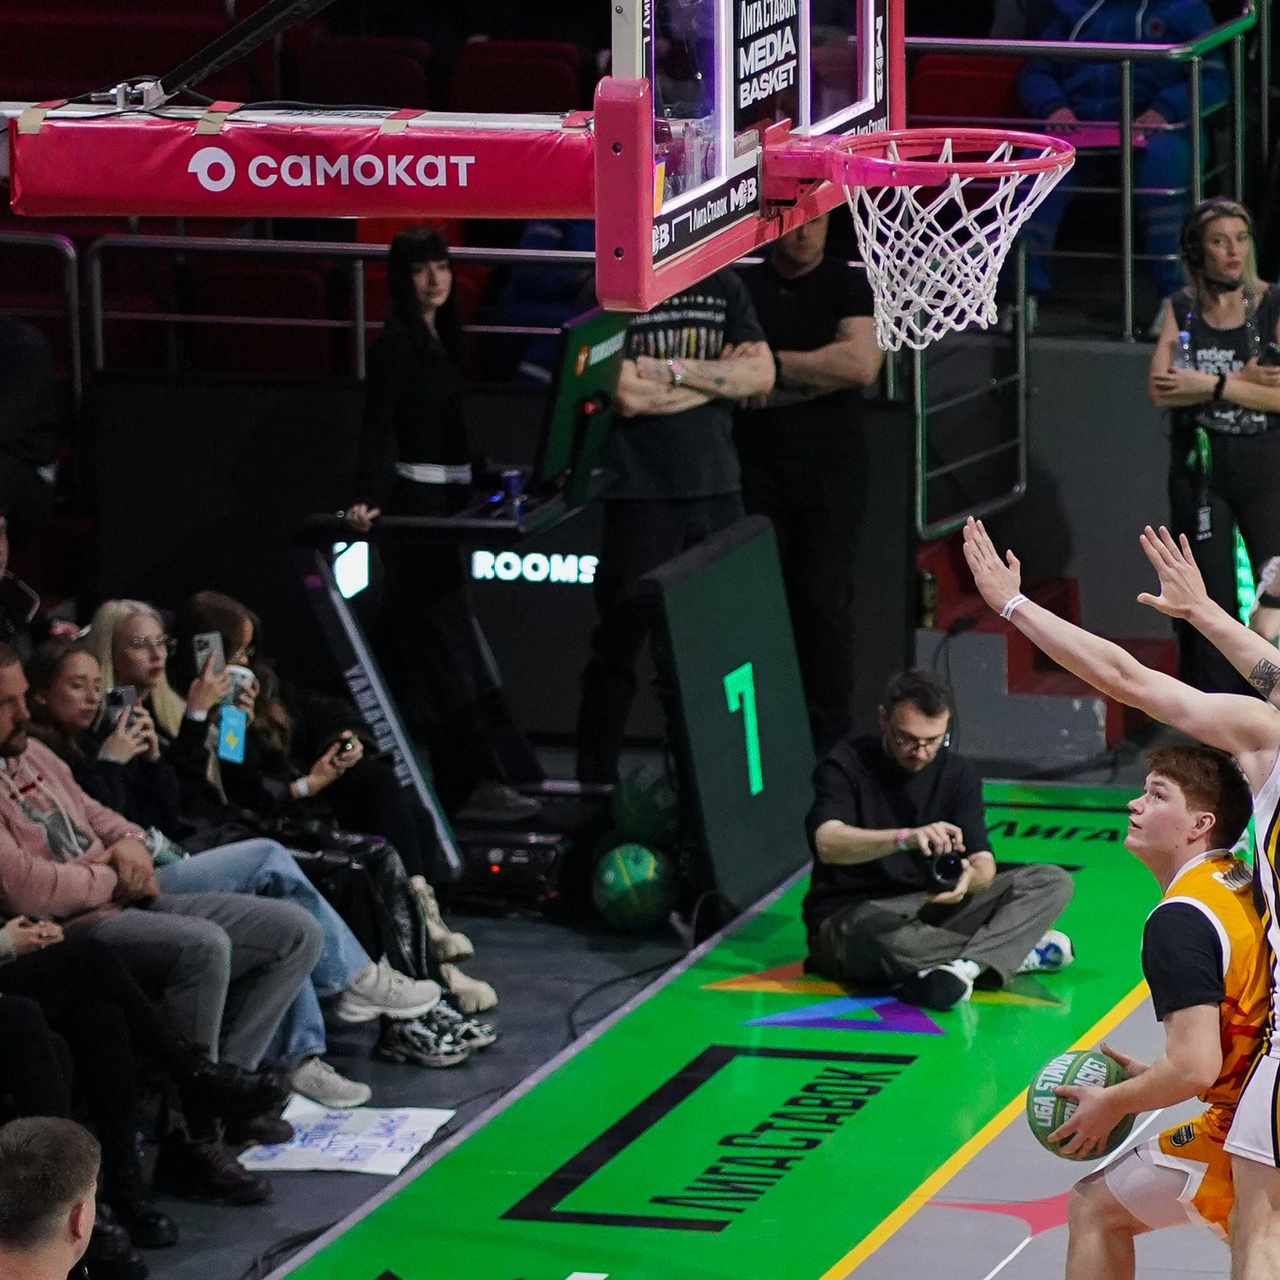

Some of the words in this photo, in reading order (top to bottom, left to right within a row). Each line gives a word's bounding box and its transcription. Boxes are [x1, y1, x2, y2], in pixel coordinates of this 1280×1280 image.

[739, 25, 797, 79] MEDIA
[739, 59, 797, 110] BASKET
[471, 550, 600, 584] ROOMS
[1074, 1058, 1108, 1090] ASKET
[1033, 1096, 1057, 1127] LIGA
